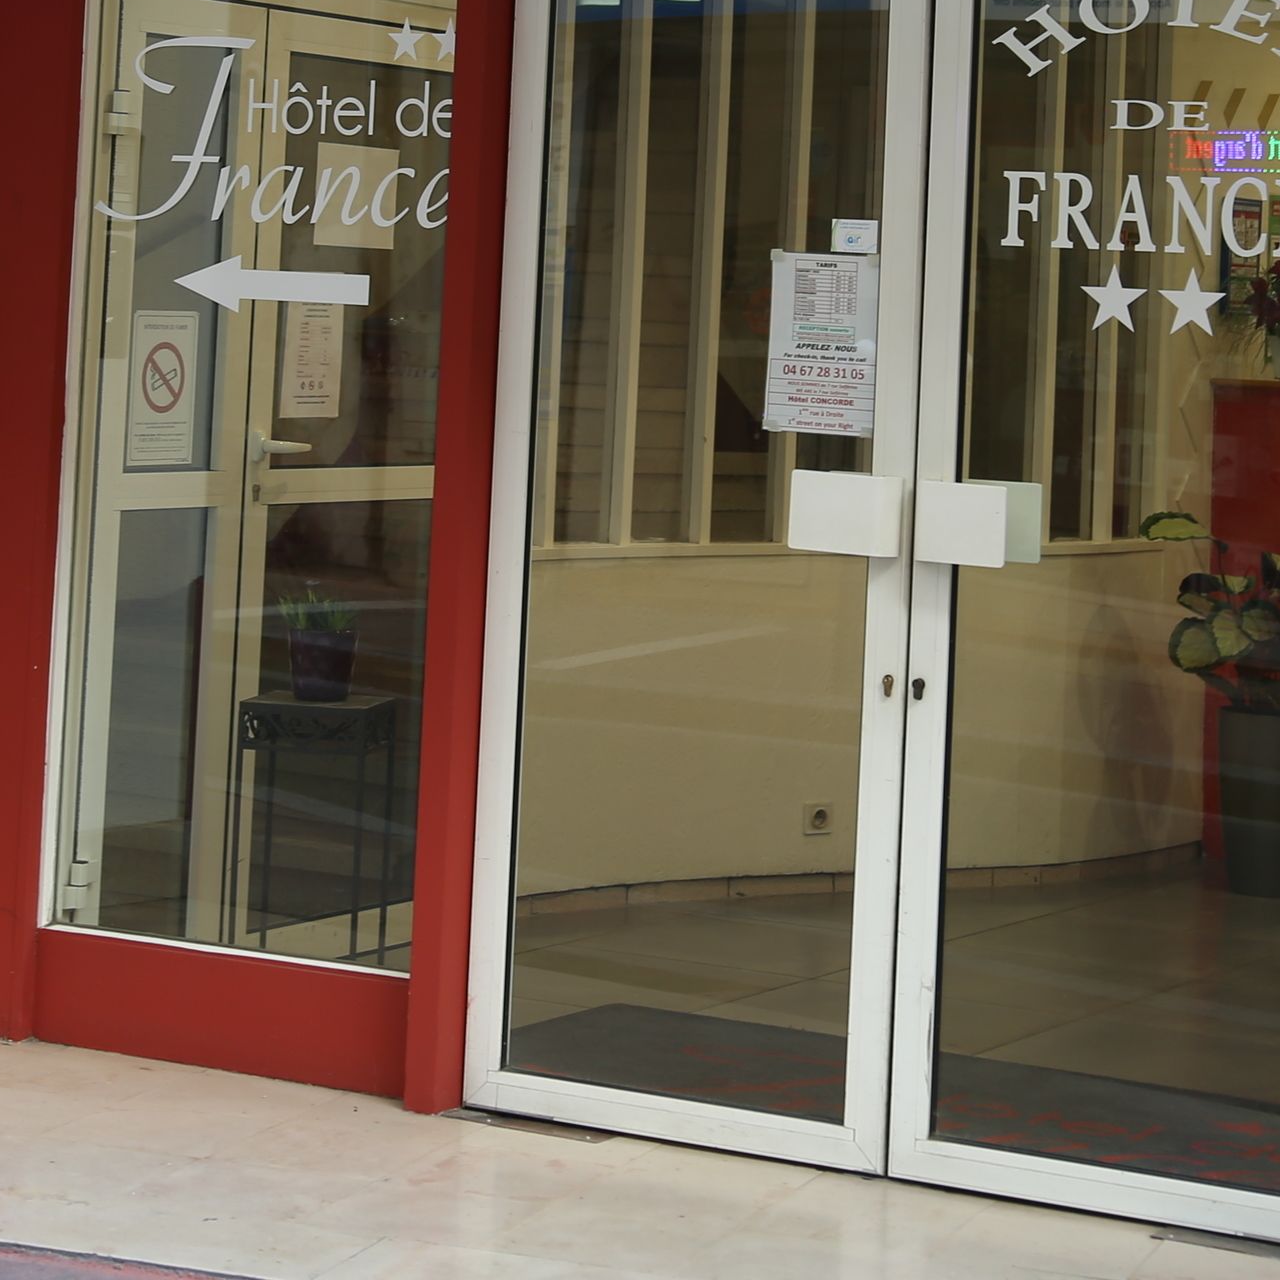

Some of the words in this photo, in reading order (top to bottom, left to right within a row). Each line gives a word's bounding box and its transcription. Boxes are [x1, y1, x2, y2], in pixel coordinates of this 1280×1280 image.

[246, 78, 377, 138] Hôtel
[395, 80, 453, 139] de
[1109, 98, 1212, 132] DE
[94, 36, 450, 230] France
[783, 364, 797, 375] 04
[799, 365, 814, 376] 67
[816, 366, 831, 378] 28
[833, 367, 848, 379] 31
[850, 368, 865, 380] 05
[810, 397, 855, 407] CONCORDE
